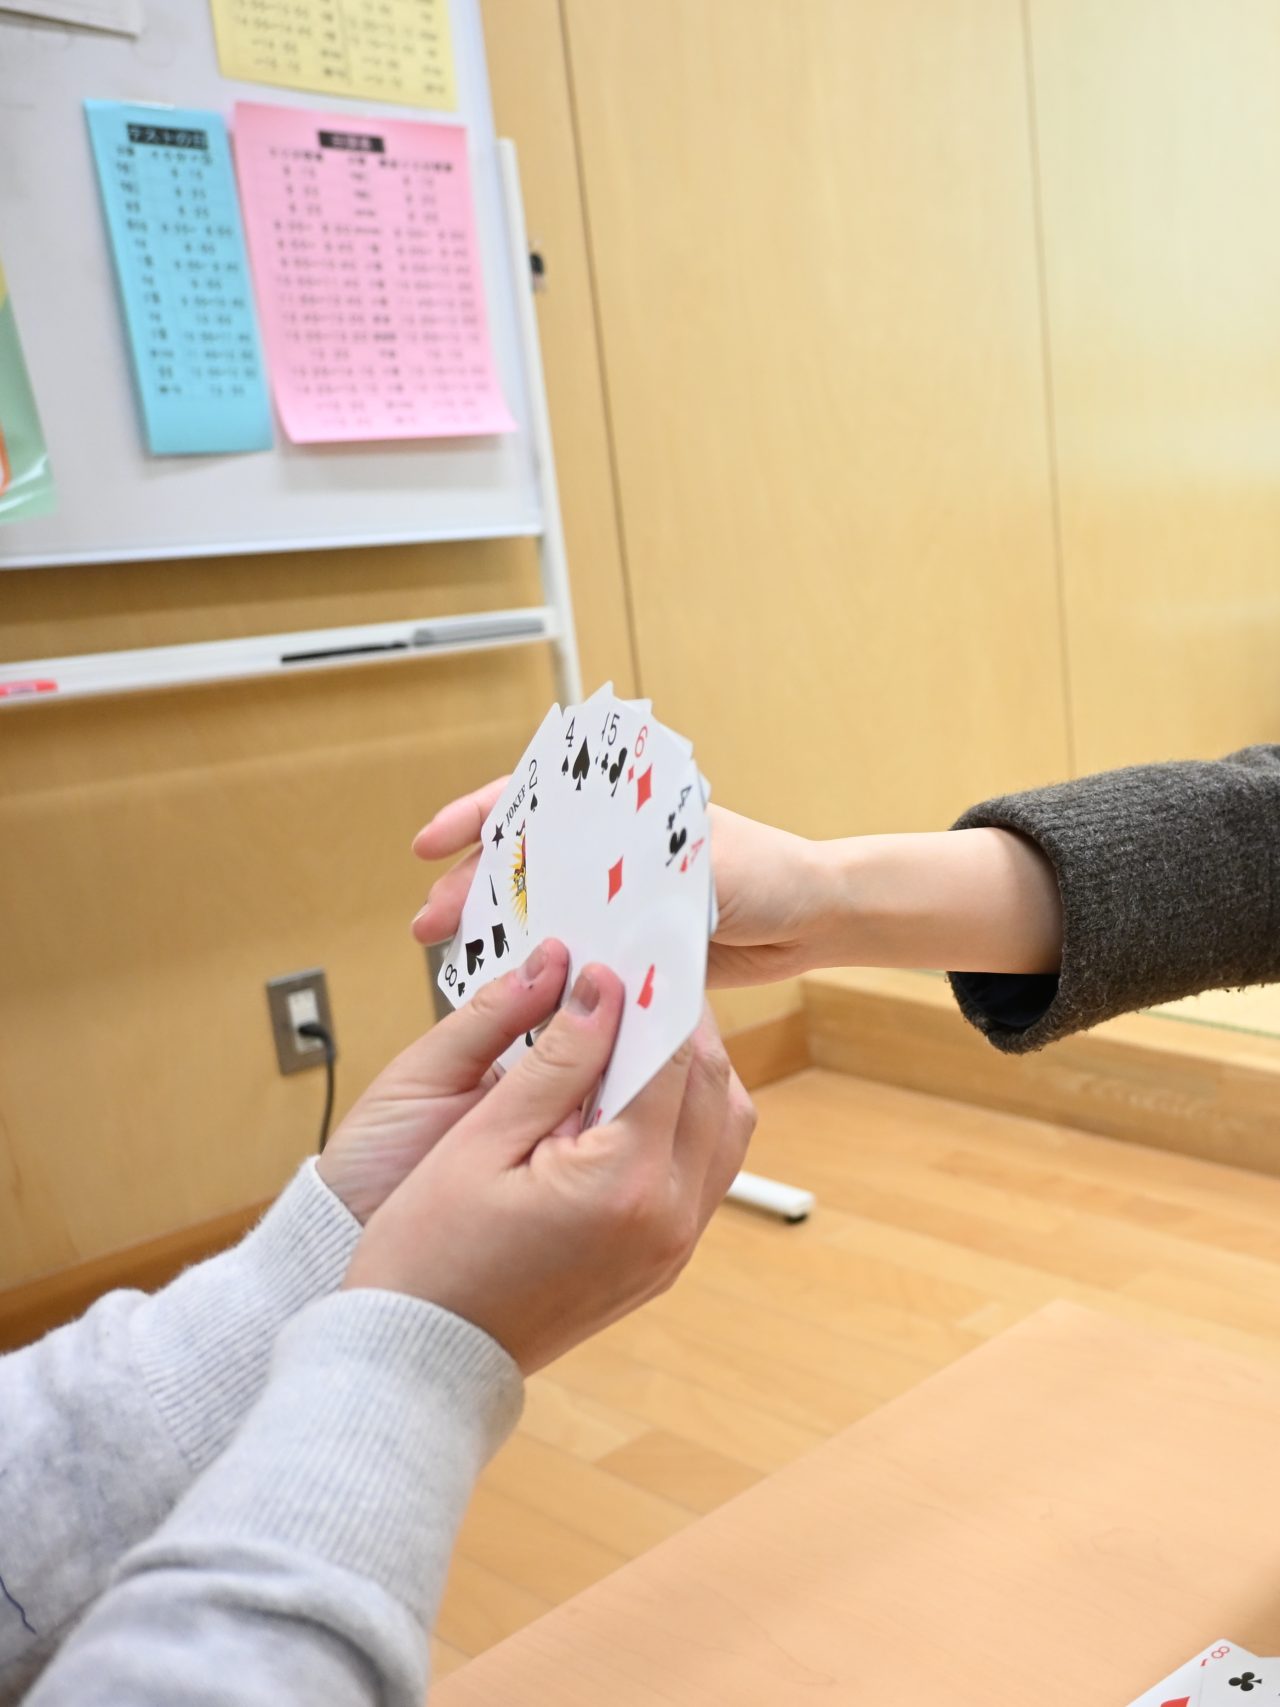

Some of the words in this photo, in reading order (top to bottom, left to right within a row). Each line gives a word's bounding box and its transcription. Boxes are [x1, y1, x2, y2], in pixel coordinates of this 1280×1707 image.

[565, 715, 576, 748] 4
[607, 713, 621, 746] 5
[634, 724, 648, 758] 6
[528, 758, 538, 790] 2
[444, 963, 458, 988] 8
[1211, 1645, 1230, 1659] 8
